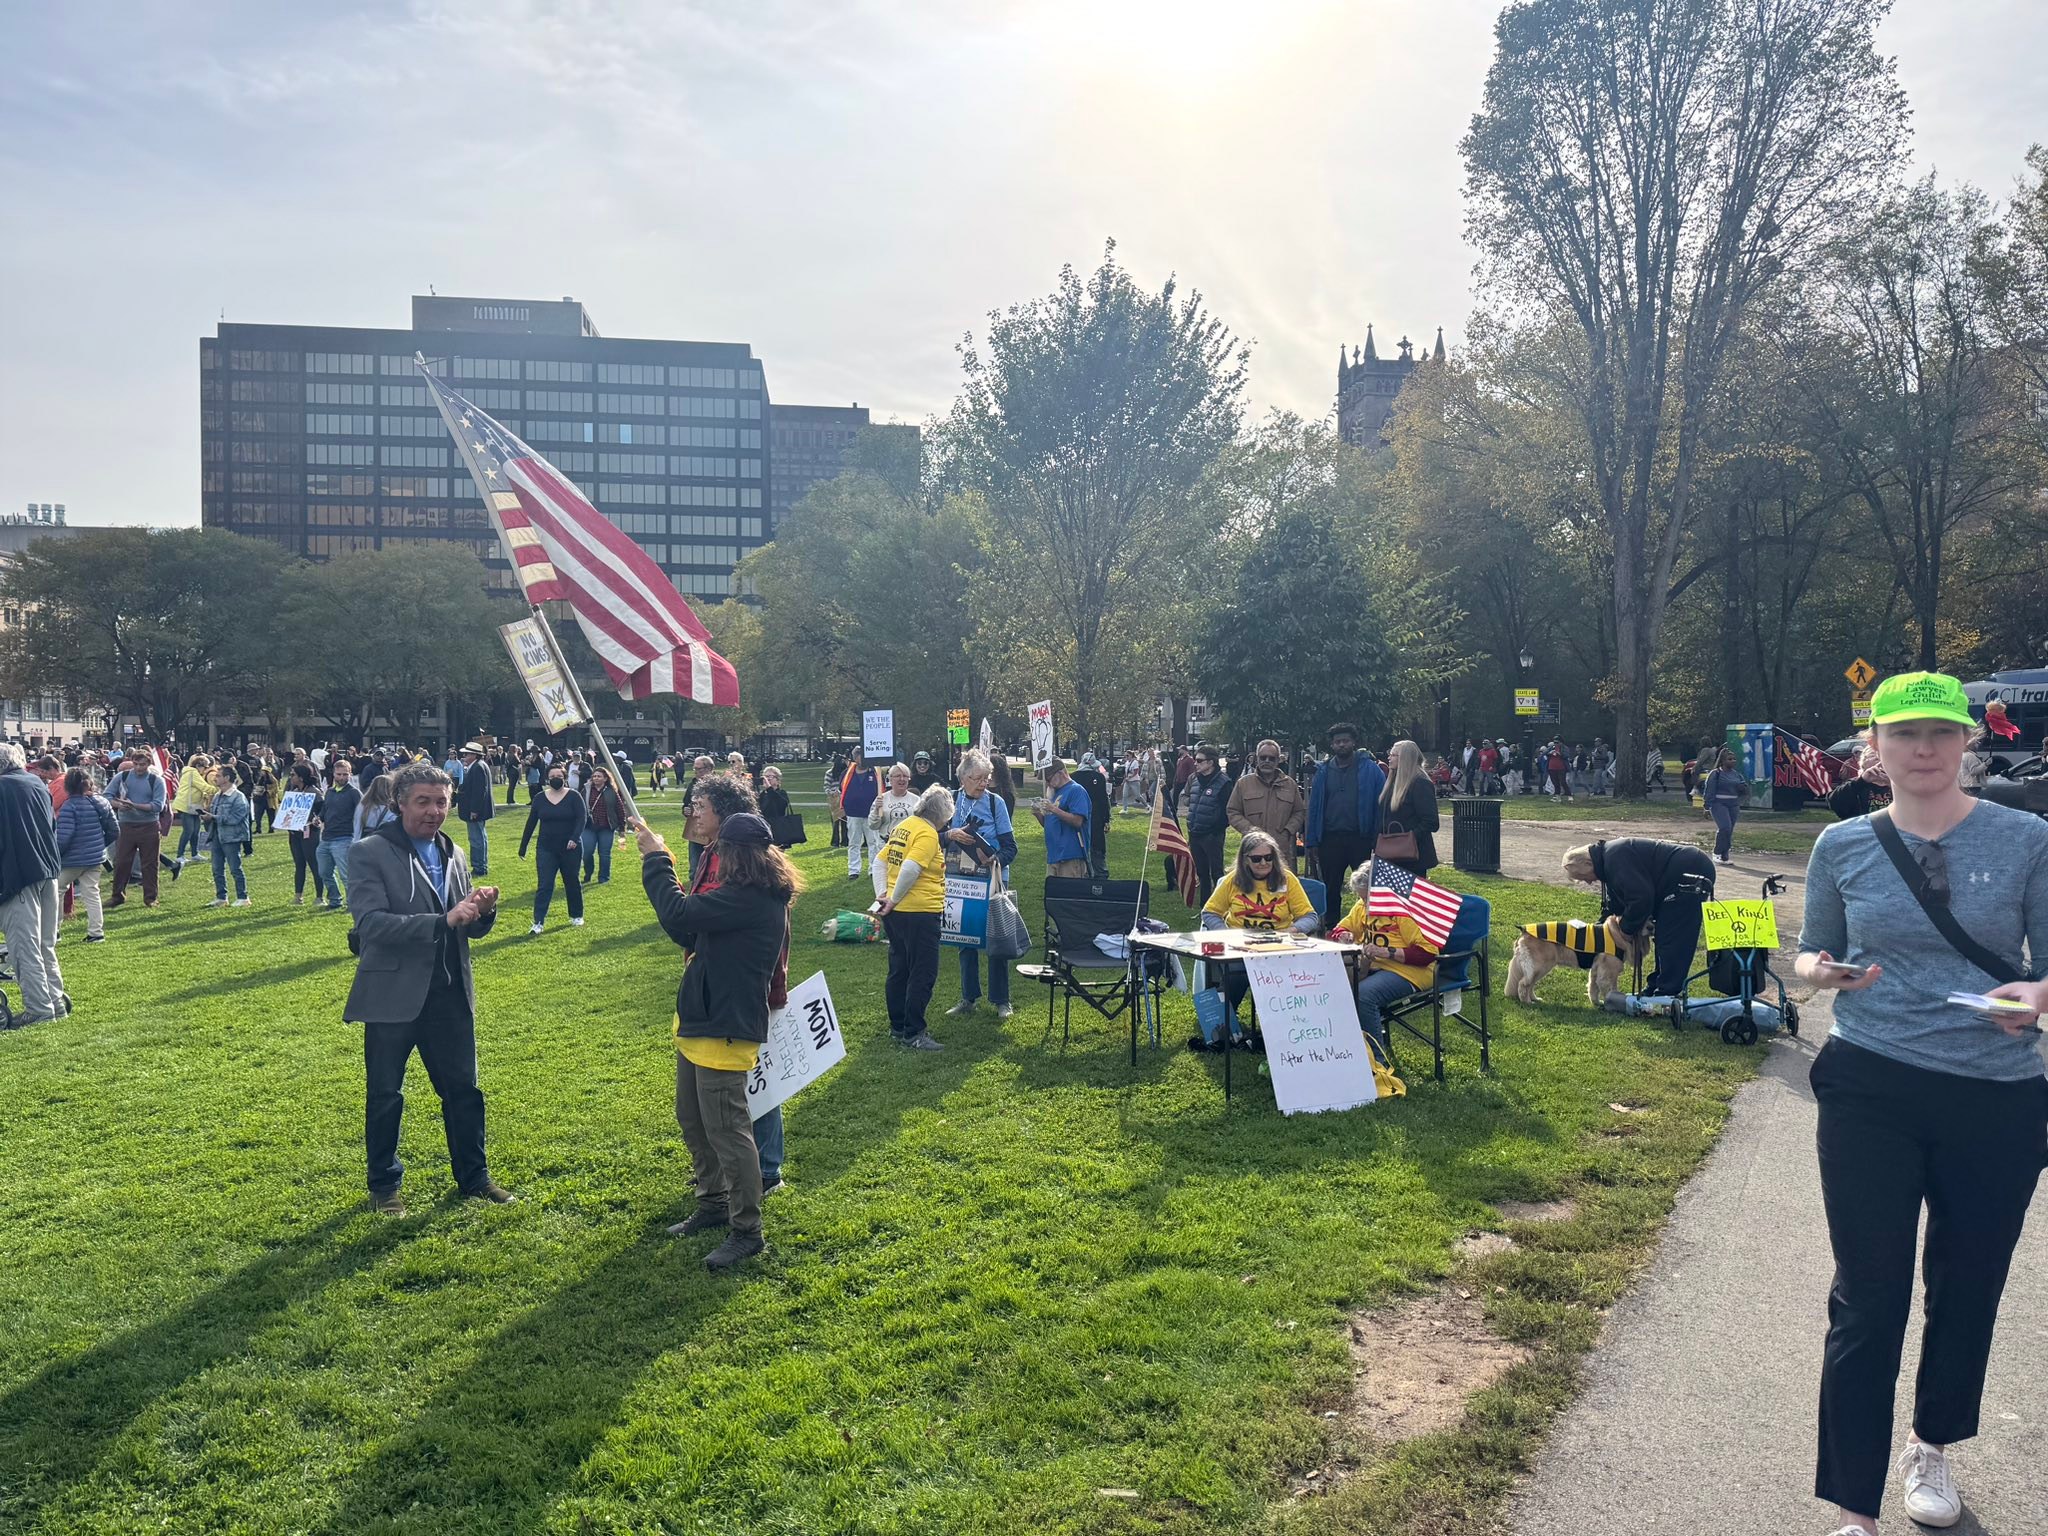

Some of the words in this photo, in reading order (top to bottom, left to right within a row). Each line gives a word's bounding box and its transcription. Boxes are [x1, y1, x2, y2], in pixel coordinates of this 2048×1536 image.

[520, 633, 537, 649] NO
[522, 645, 551, 668] KINGS
[1906, 679, 1945, 689] National
[1906, 686, 1947, 695] Lawyers
[2000, 688, 2018, 702] CT
[1031, 704, 1050, 721] MAGA
[1706, 908, 1728, 921] BEE
[1708, 935, 1730, 943] DOGS
[1253, 969, 1284, 990] Help
[1269, 995, 1308, 1012] CLEAN
[1313, 992, 1330, 1007] UP
[803, 998, 832, 1051] NOW
[1292, 1014, 1307, 1023] the
[1288, 1018, 1333, 1044] GREEN!
[771, 1018, 797, 1081] ADELITA
[785, 1008, 810, 1076] GRIJALVA
[762, 1050, 773, 1070] IN
[1280, 1050, 1304, 1069] After
[1308, 1049, 1325, 1062] the
[1325, 1046, 1354, 1062] March
